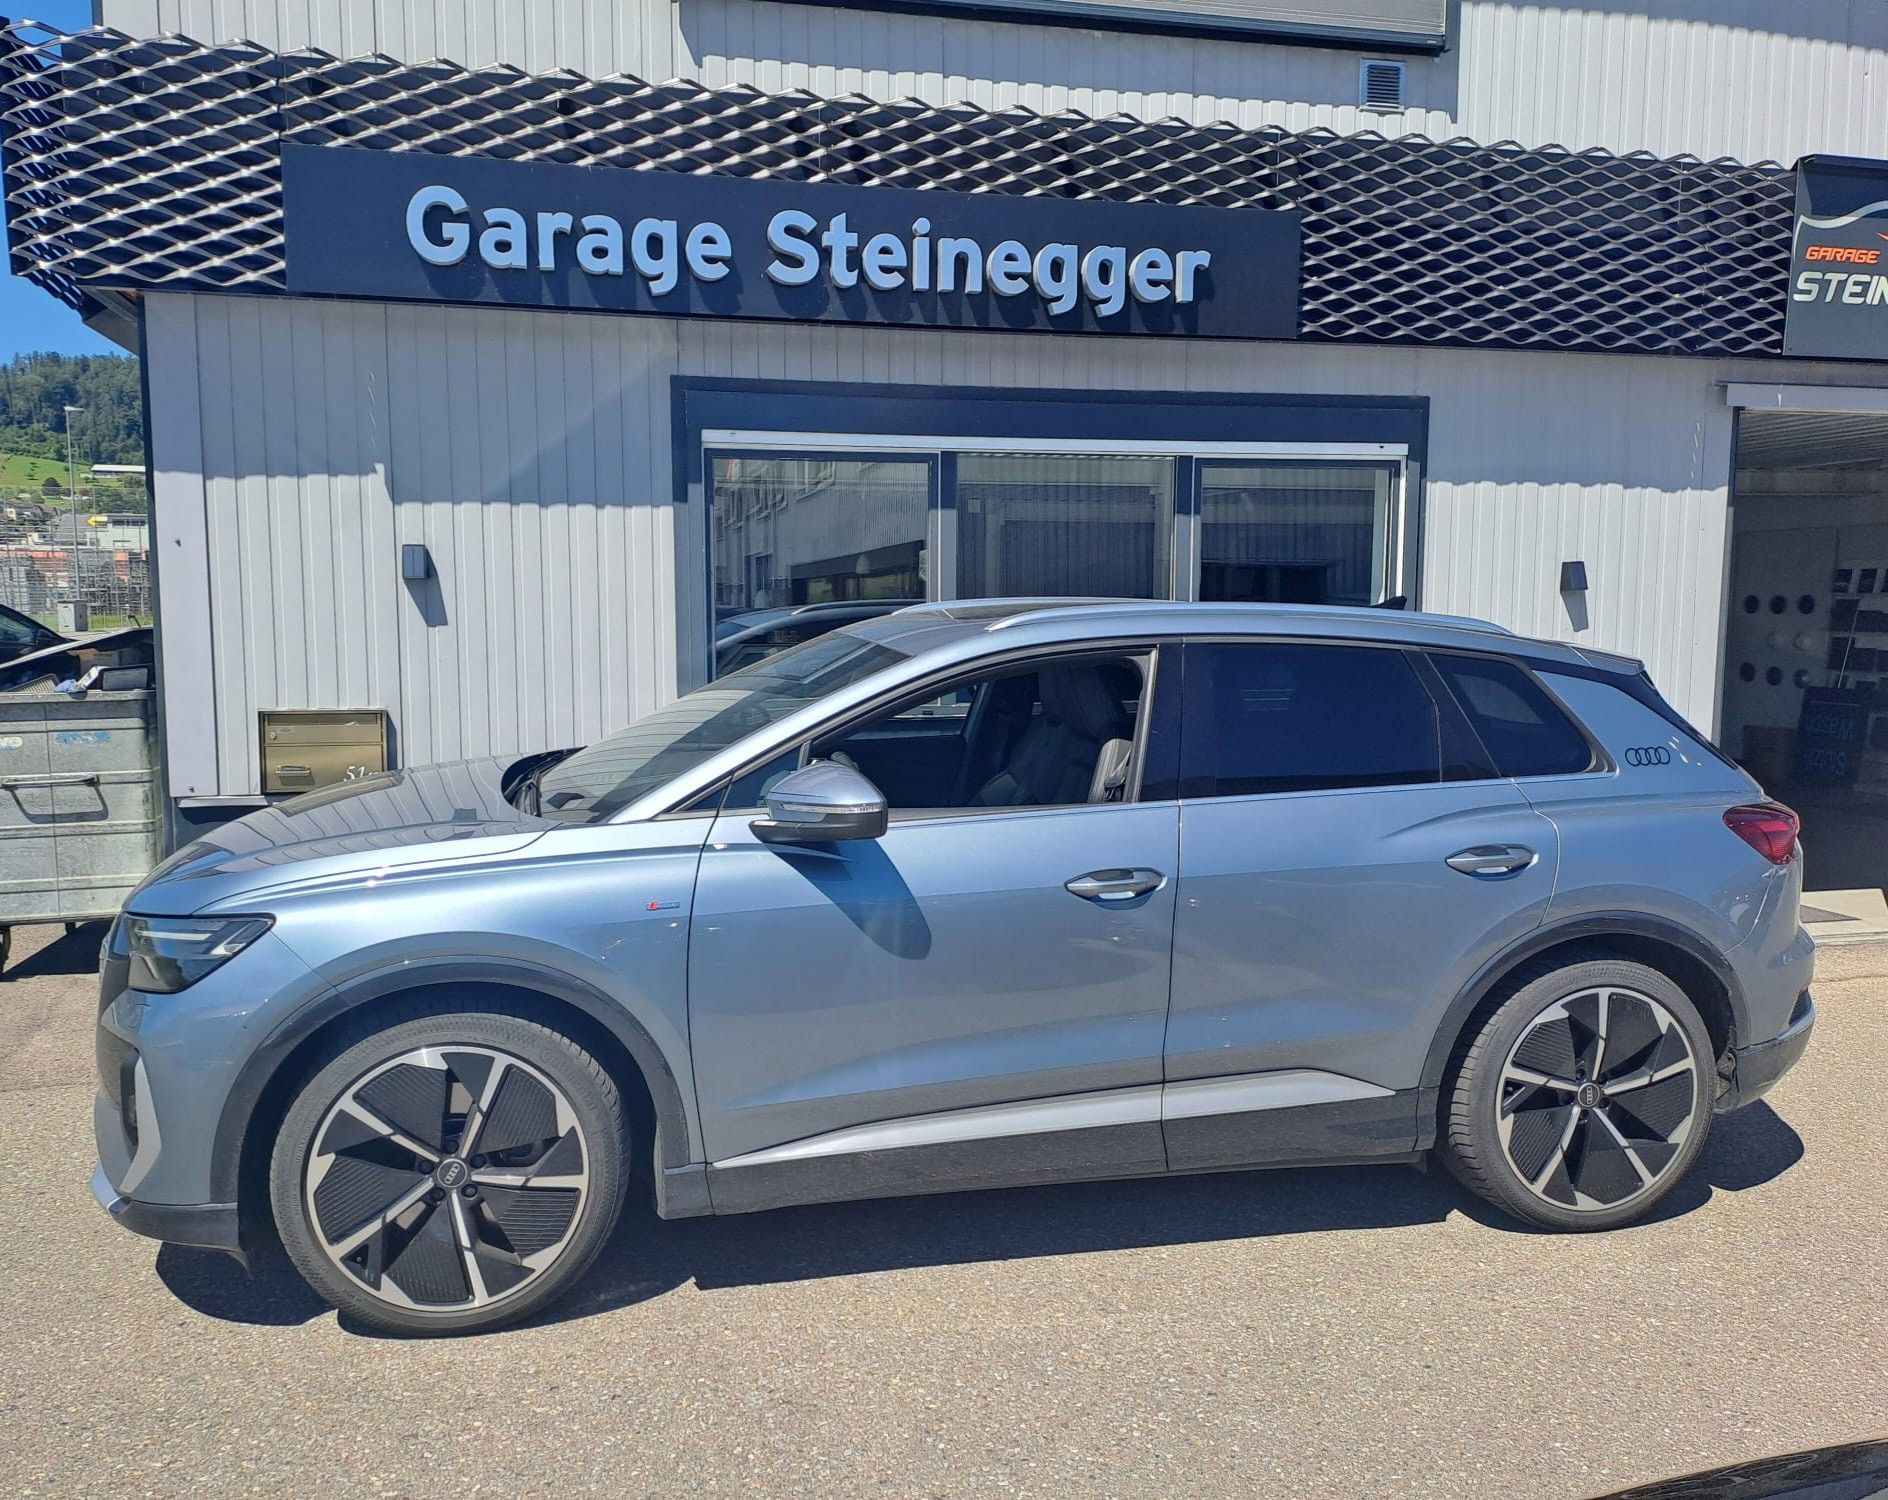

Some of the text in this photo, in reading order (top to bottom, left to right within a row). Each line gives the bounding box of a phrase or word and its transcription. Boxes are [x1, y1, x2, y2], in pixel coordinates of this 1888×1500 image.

[406, 185, 1211, 317] Garage Steinegger
[1805, 246, 1881, 264] GARAGE
